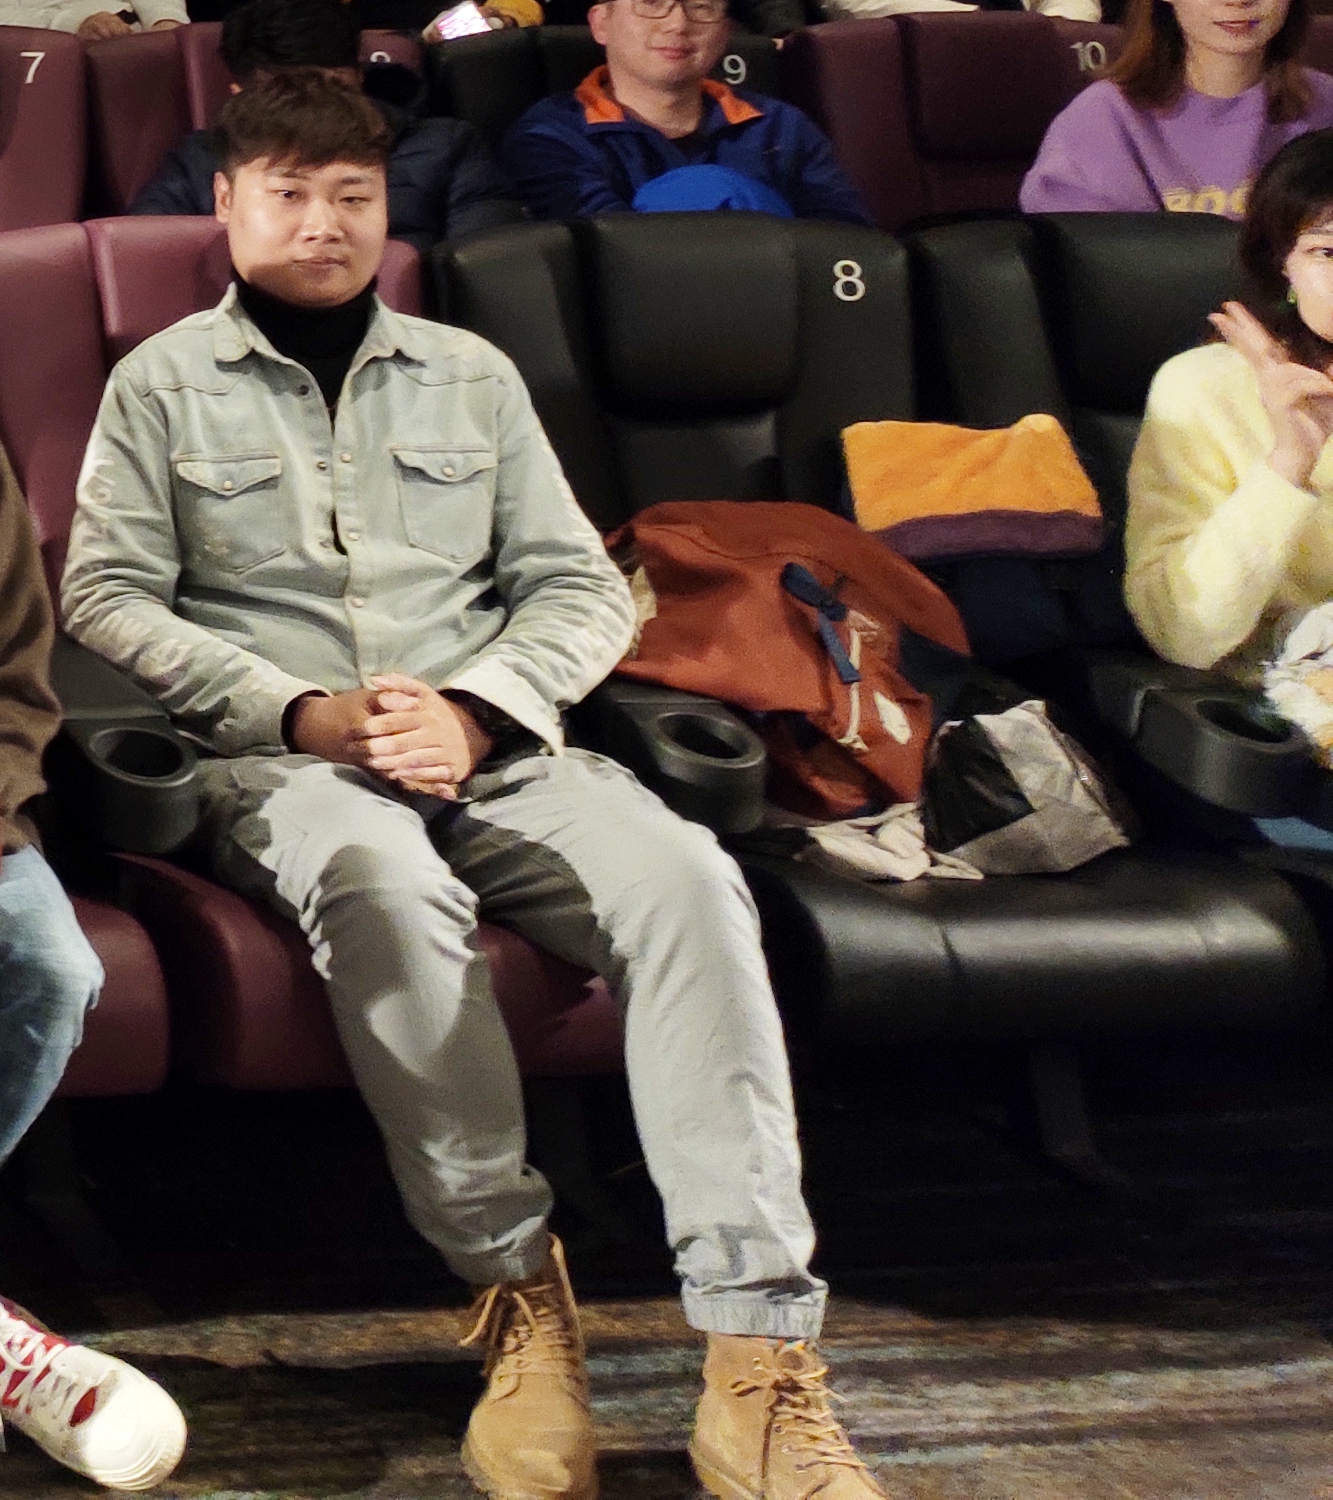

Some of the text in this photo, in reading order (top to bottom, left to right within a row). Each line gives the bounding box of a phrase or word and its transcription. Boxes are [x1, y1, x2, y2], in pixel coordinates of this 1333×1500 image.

[20, 51, 46, 84] 7
[723, 54, 746, 85] 9
[1068, 41, 1107, 71] 10
[829, 259, 863, 303] 8
